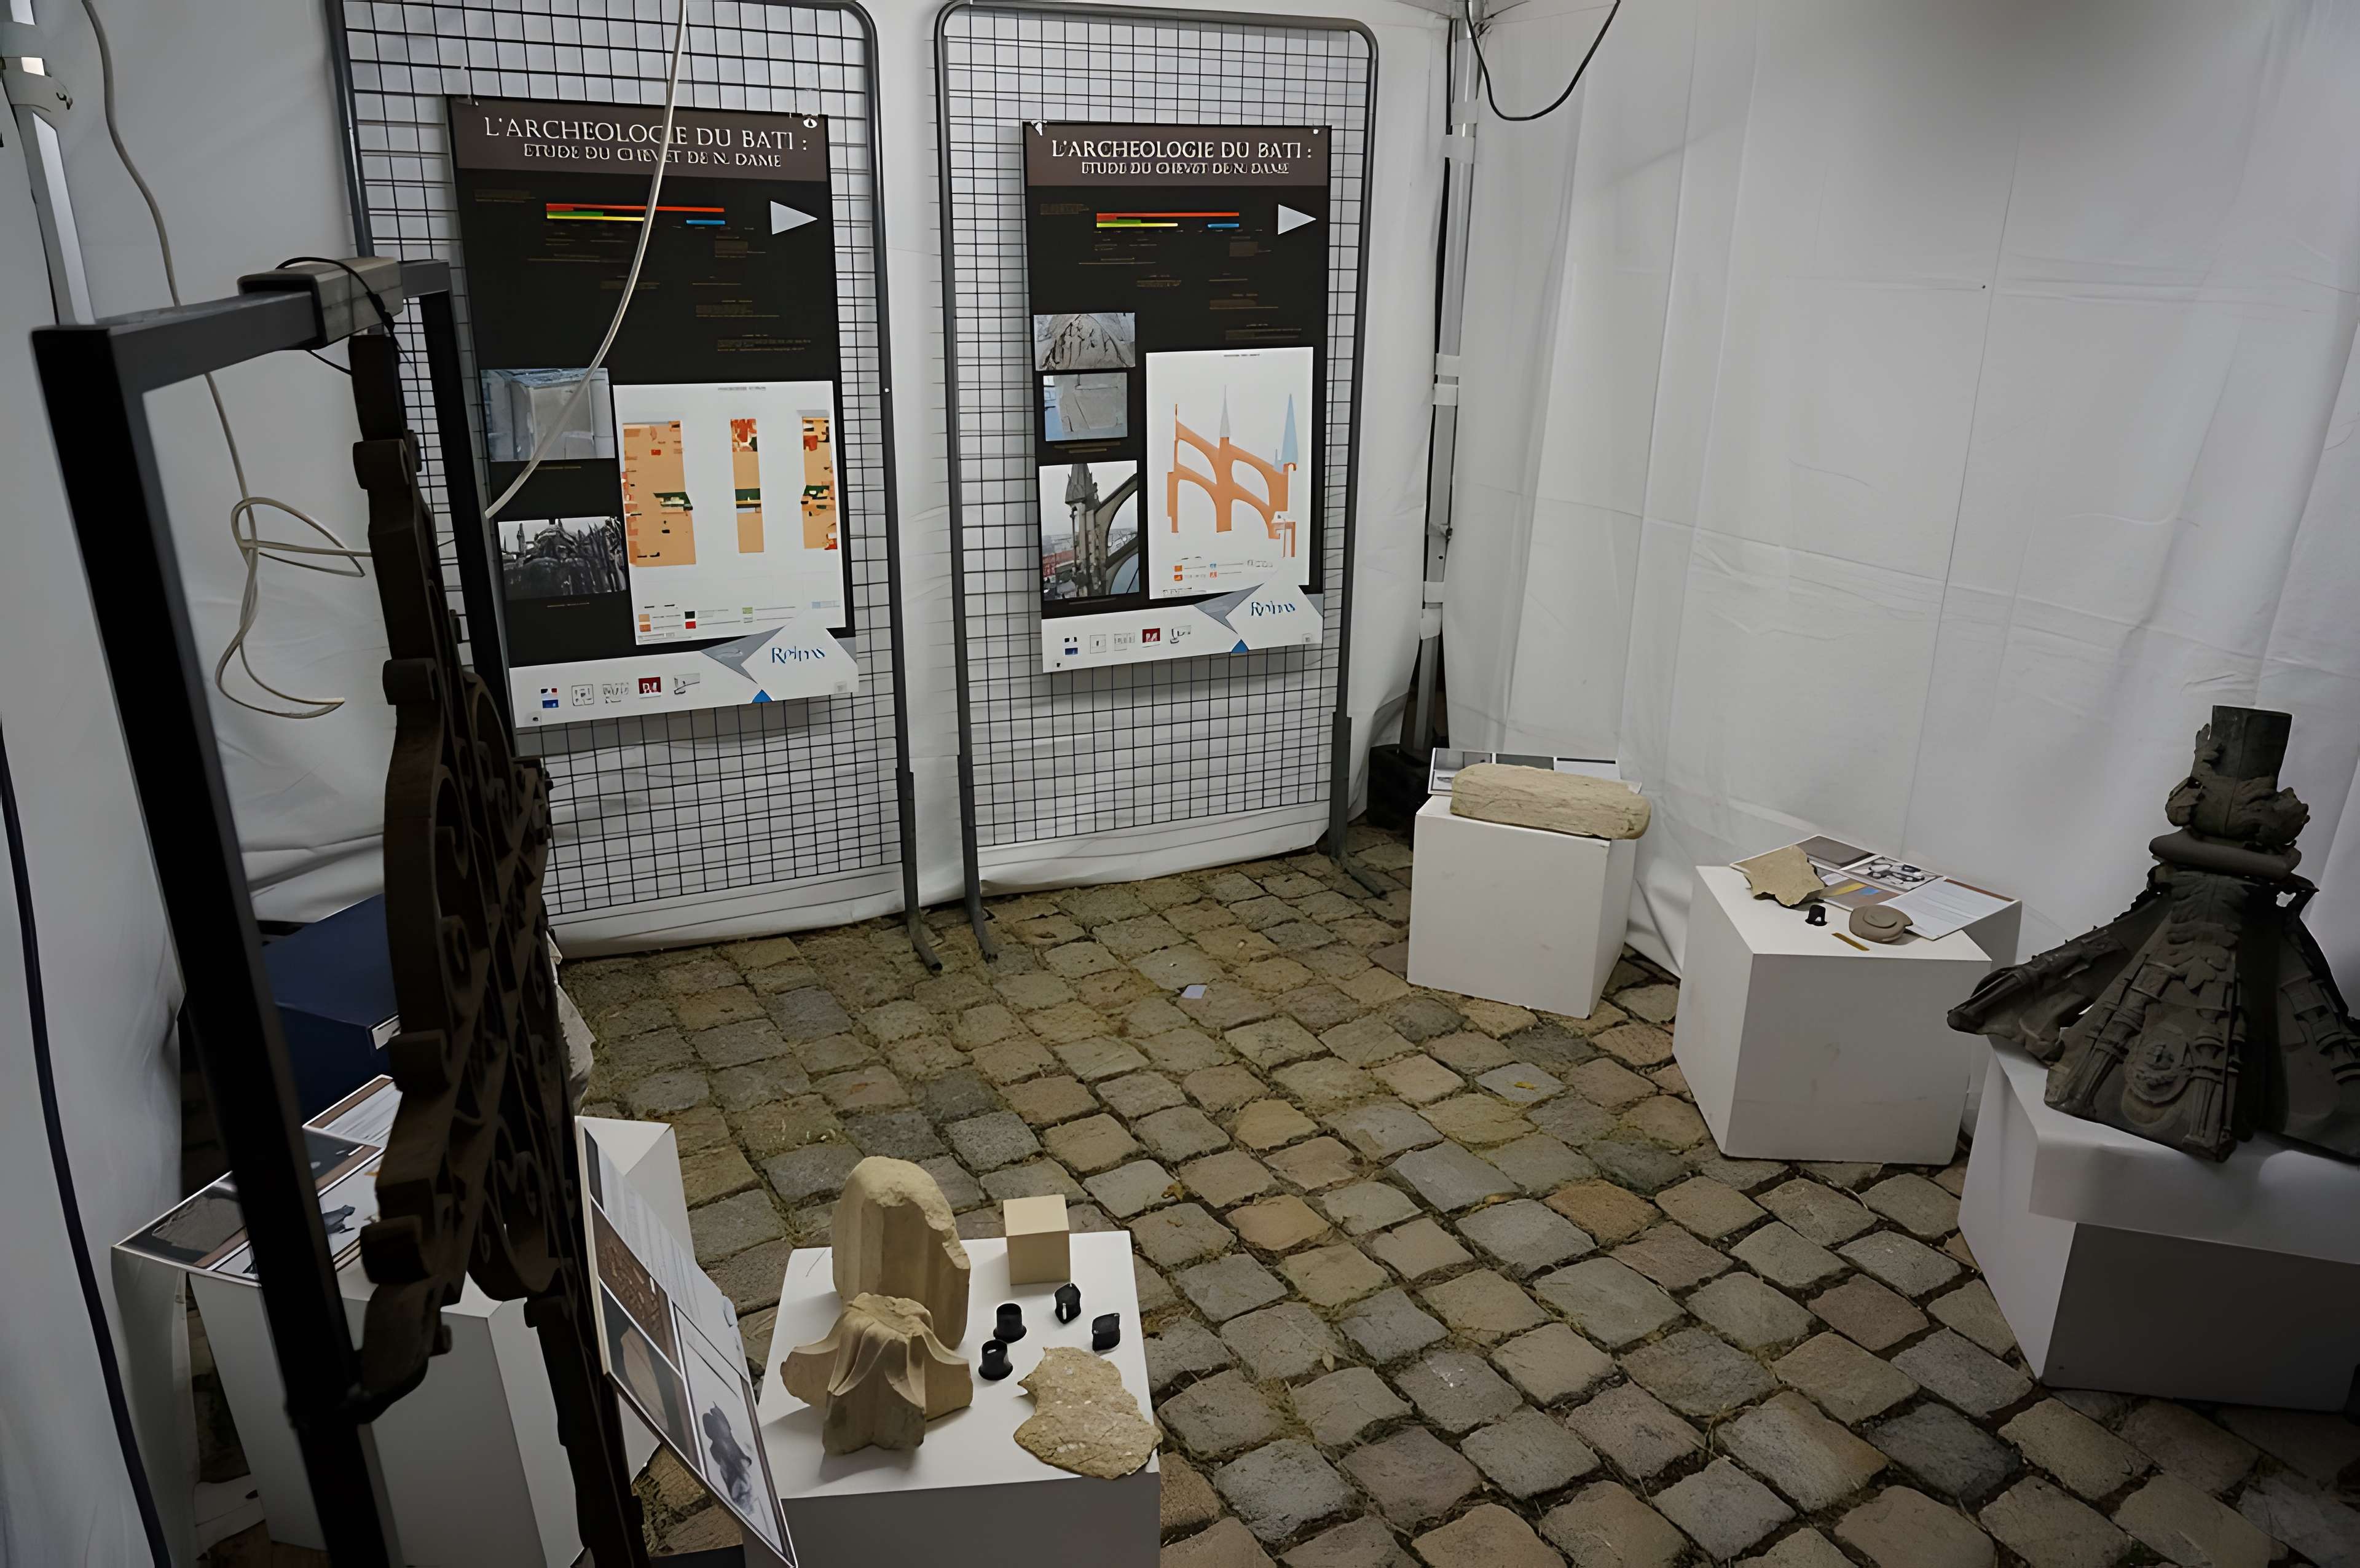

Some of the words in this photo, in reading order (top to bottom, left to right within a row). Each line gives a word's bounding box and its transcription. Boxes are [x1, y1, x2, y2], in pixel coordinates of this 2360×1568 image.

[696, 127, 731, 147] DU
[742, 130, 793, 150] BATI
[1052, 139, 1214, 158] L'ARCHEOLOGIE
[1221, 141, 1249, 158] DU
[1258, 142, 1301, 159] BATI
[524, 143, 580, 159] ETUDE
[585, 146, 610, 160] DU
[688, 151, 709, 165] DE
[735, 153, 781, 167] DAME
[1130, 162, 1152, 174] DU
